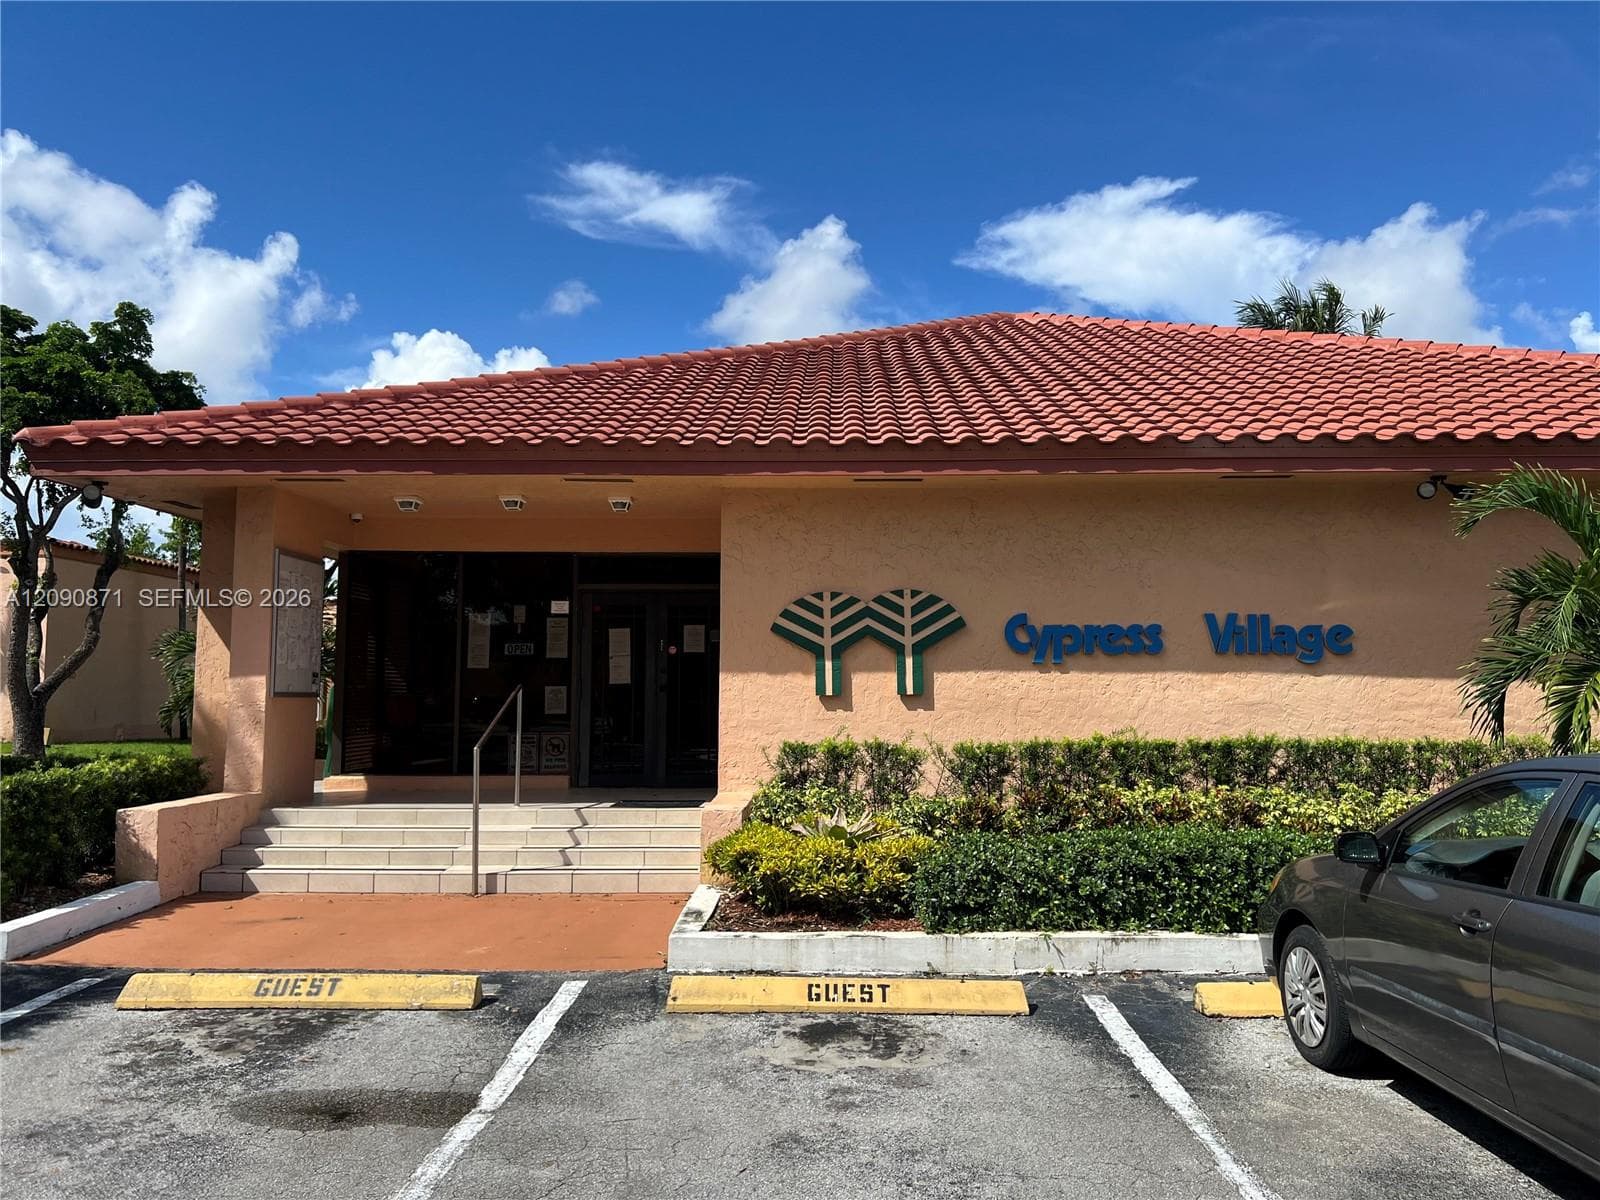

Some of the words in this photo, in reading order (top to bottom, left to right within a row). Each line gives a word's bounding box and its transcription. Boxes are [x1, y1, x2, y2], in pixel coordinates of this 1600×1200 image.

[1004, 612, 1164, 664] Cypress
[1204, 612, 1354, 664] Village
[508, 644, 532, 654] OPEN
[254, 977, 343, 997] GUEST
[807, 983, 891, 1003] GUEST
